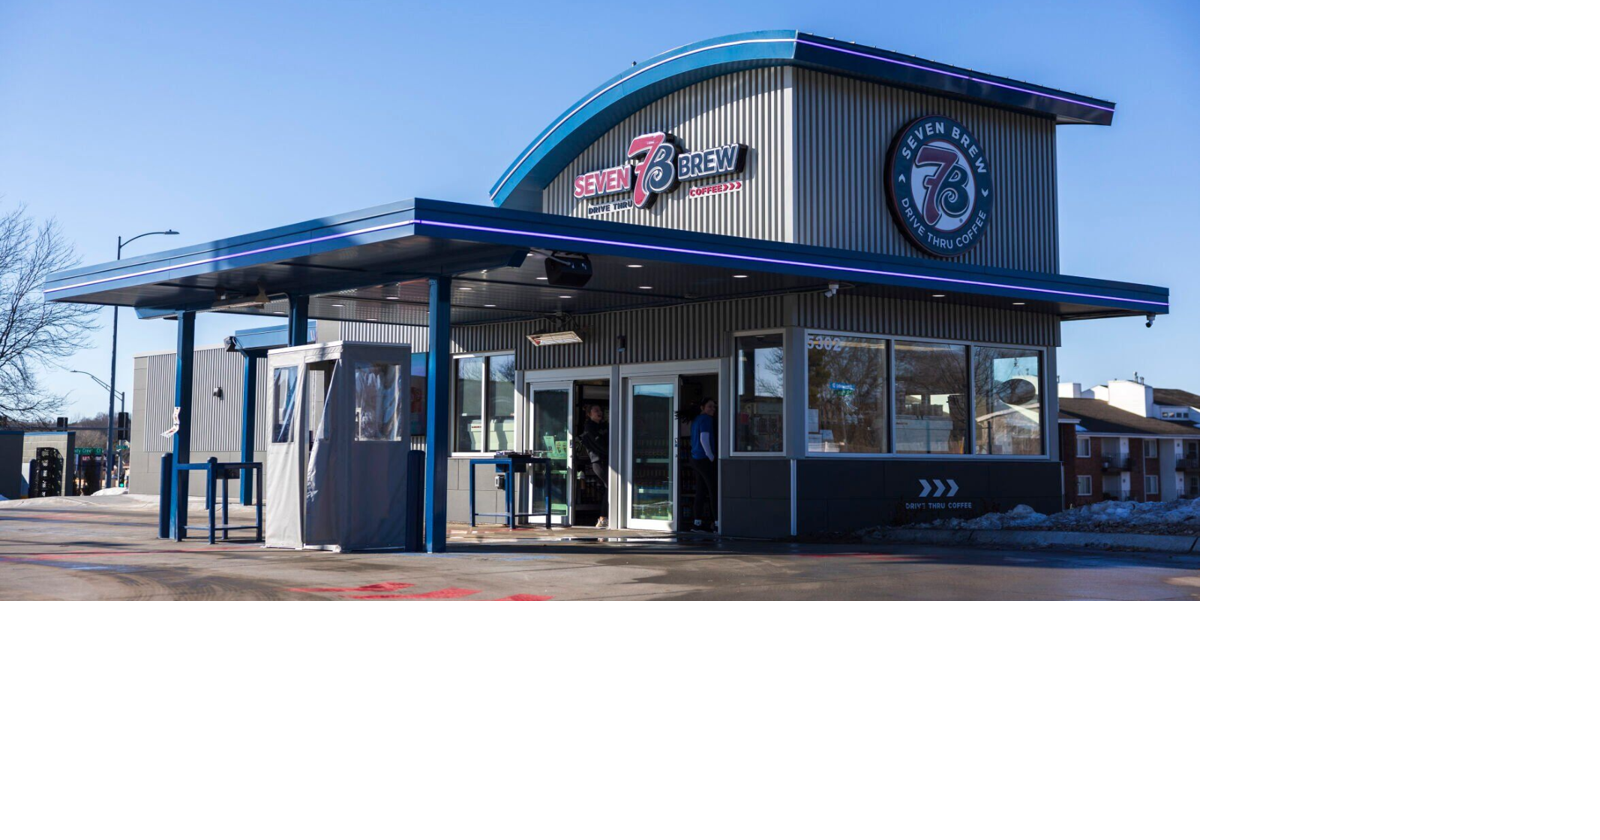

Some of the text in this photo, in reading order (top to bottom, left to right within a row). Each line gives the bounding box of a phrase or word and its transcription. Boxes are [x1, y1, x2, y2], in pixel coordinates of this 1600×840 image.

[902, 122, 987, 173] SEVEN BREW
[574, 131, 739, 208] SEVEN 7B BREW
[915, 144, 970, 226] 7B
[588, 200, 633, 215] DRIVE THRU
[689, 185, 722, 198] COFFEE
[902, 198, 986, 249] DRIVE THRU COFFEE
[806, 335, 841, 351] 5302
[928, 502, 945, 510] THRU
